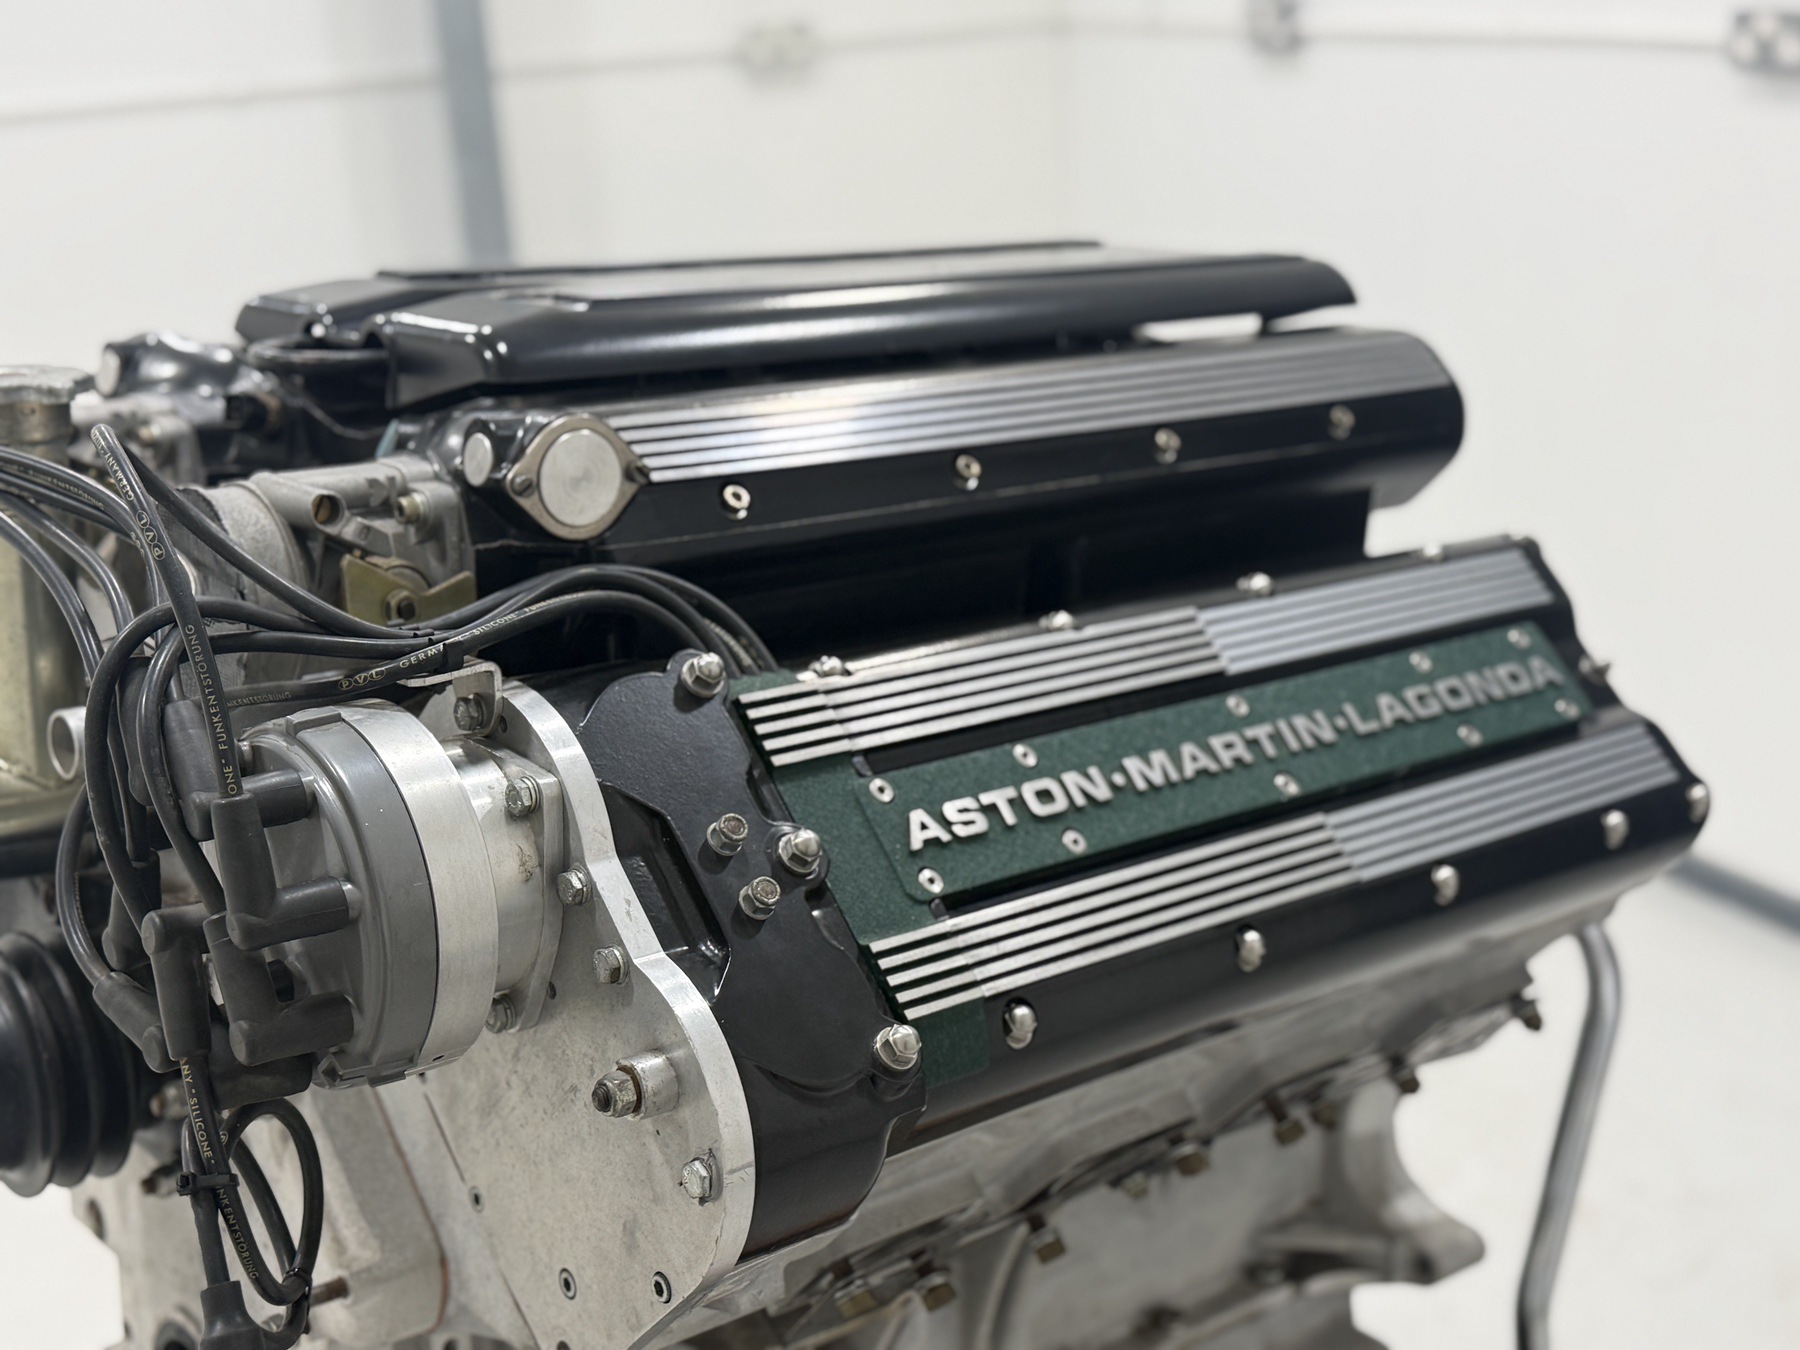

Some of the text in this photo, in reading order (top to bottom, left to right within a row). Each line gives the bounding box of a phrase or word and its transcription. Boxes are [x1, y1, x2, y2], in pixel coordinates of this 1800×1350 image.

[104, 452, 134, 501] GERMANY
[185, 624, 228, 750] FUNKENTSTÖRUNG
[190, 1097, 213, 1158] SILICONE
[216, 1186, 259, 1280] NKENTSTÖRUNG
